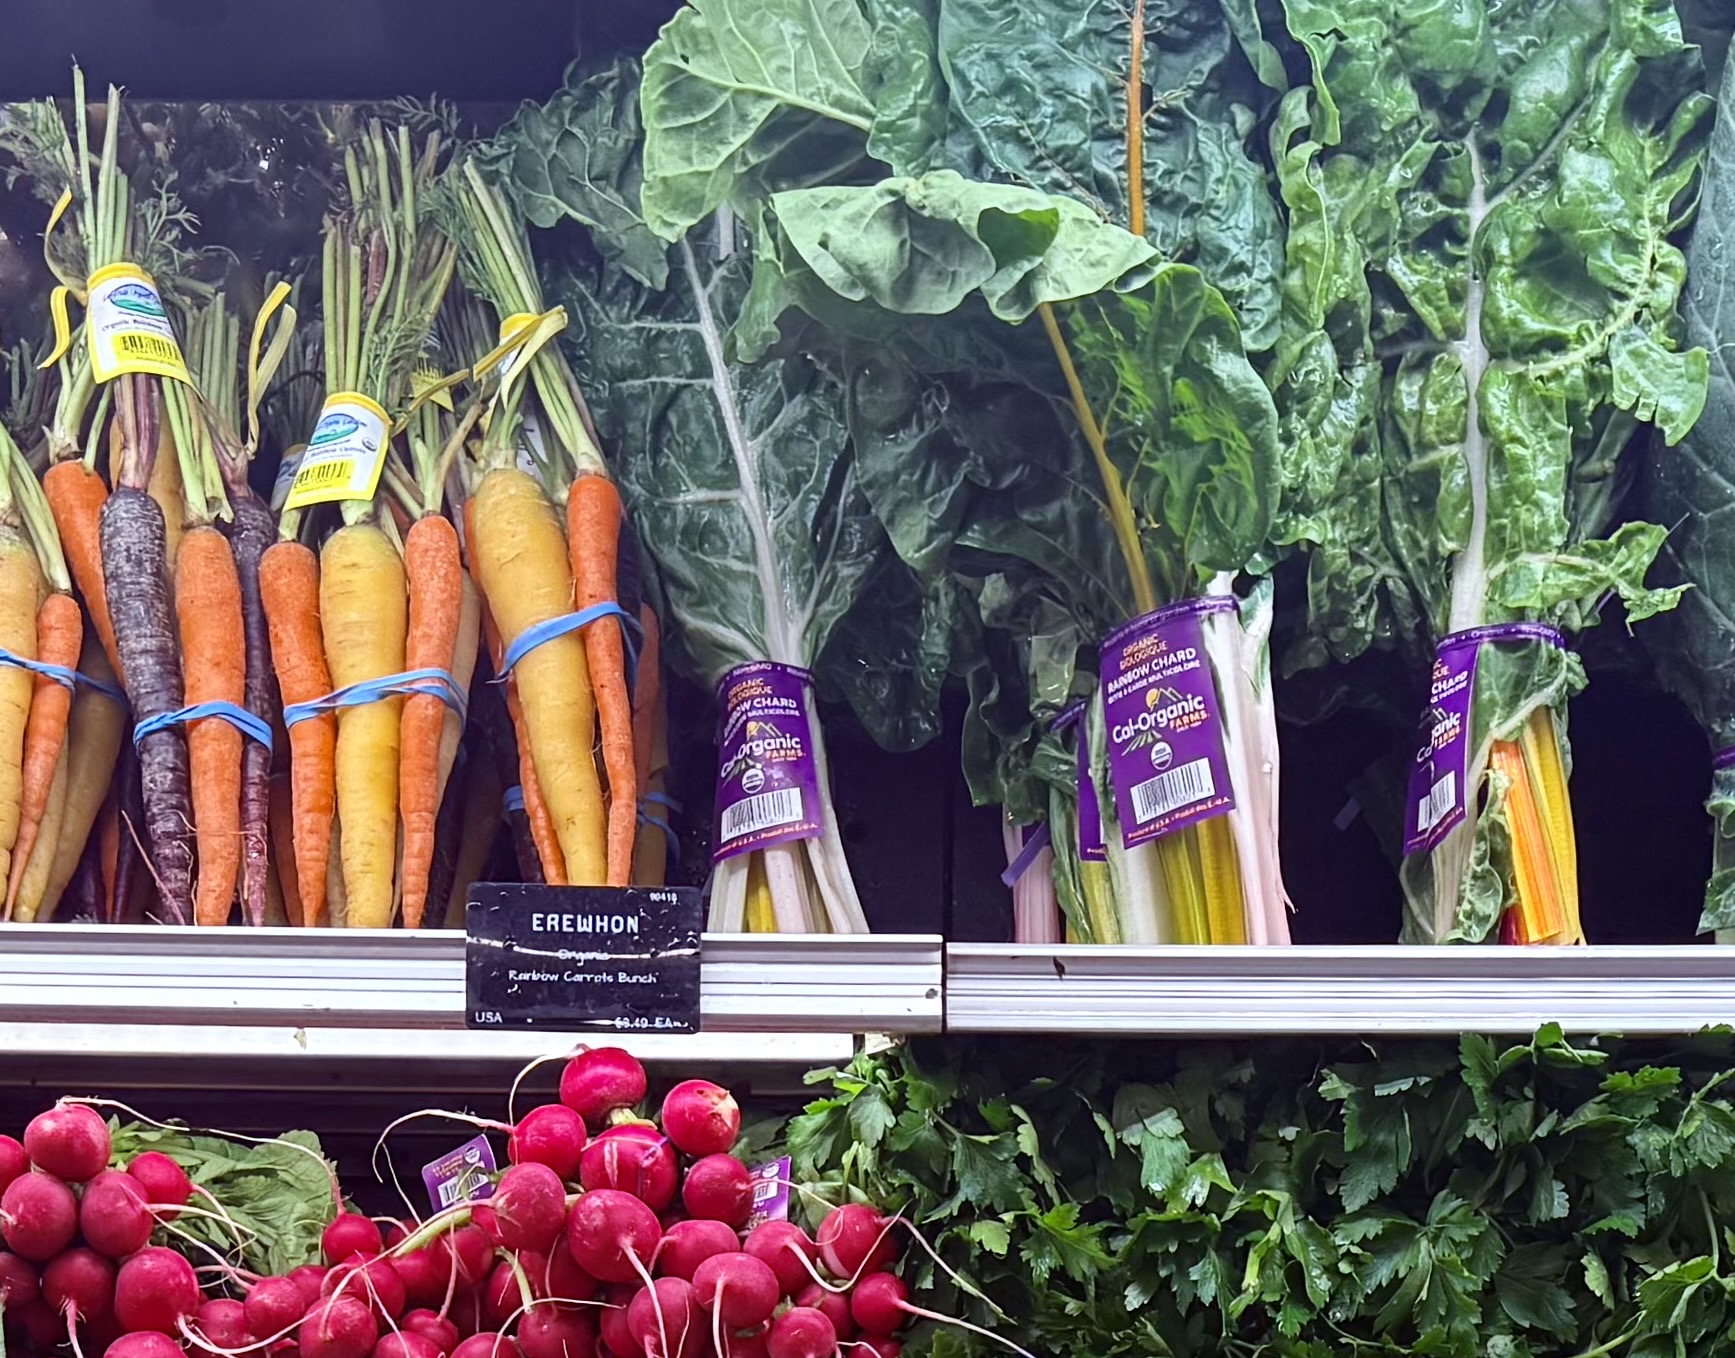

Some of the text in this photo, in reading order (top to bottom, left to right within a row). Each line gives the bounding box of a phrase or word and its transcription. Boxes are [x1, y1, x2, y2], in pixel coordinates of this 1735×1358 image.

[1123, 634, 1159, 656] ORGANIC
[1108, 647, 1196, 694] RAINBOW CHARD
[753, 698, 796, 708] CHARD
[1113, 693, 1205, 743] Cal-Organic
[1170, 712, 1208, 729] FARMS
[533, 914, 639, 932] EREWHON
[509, 971, 657, 983] Rainbow Carrots Bunch
[475, 1012, 502, 1023] USA
